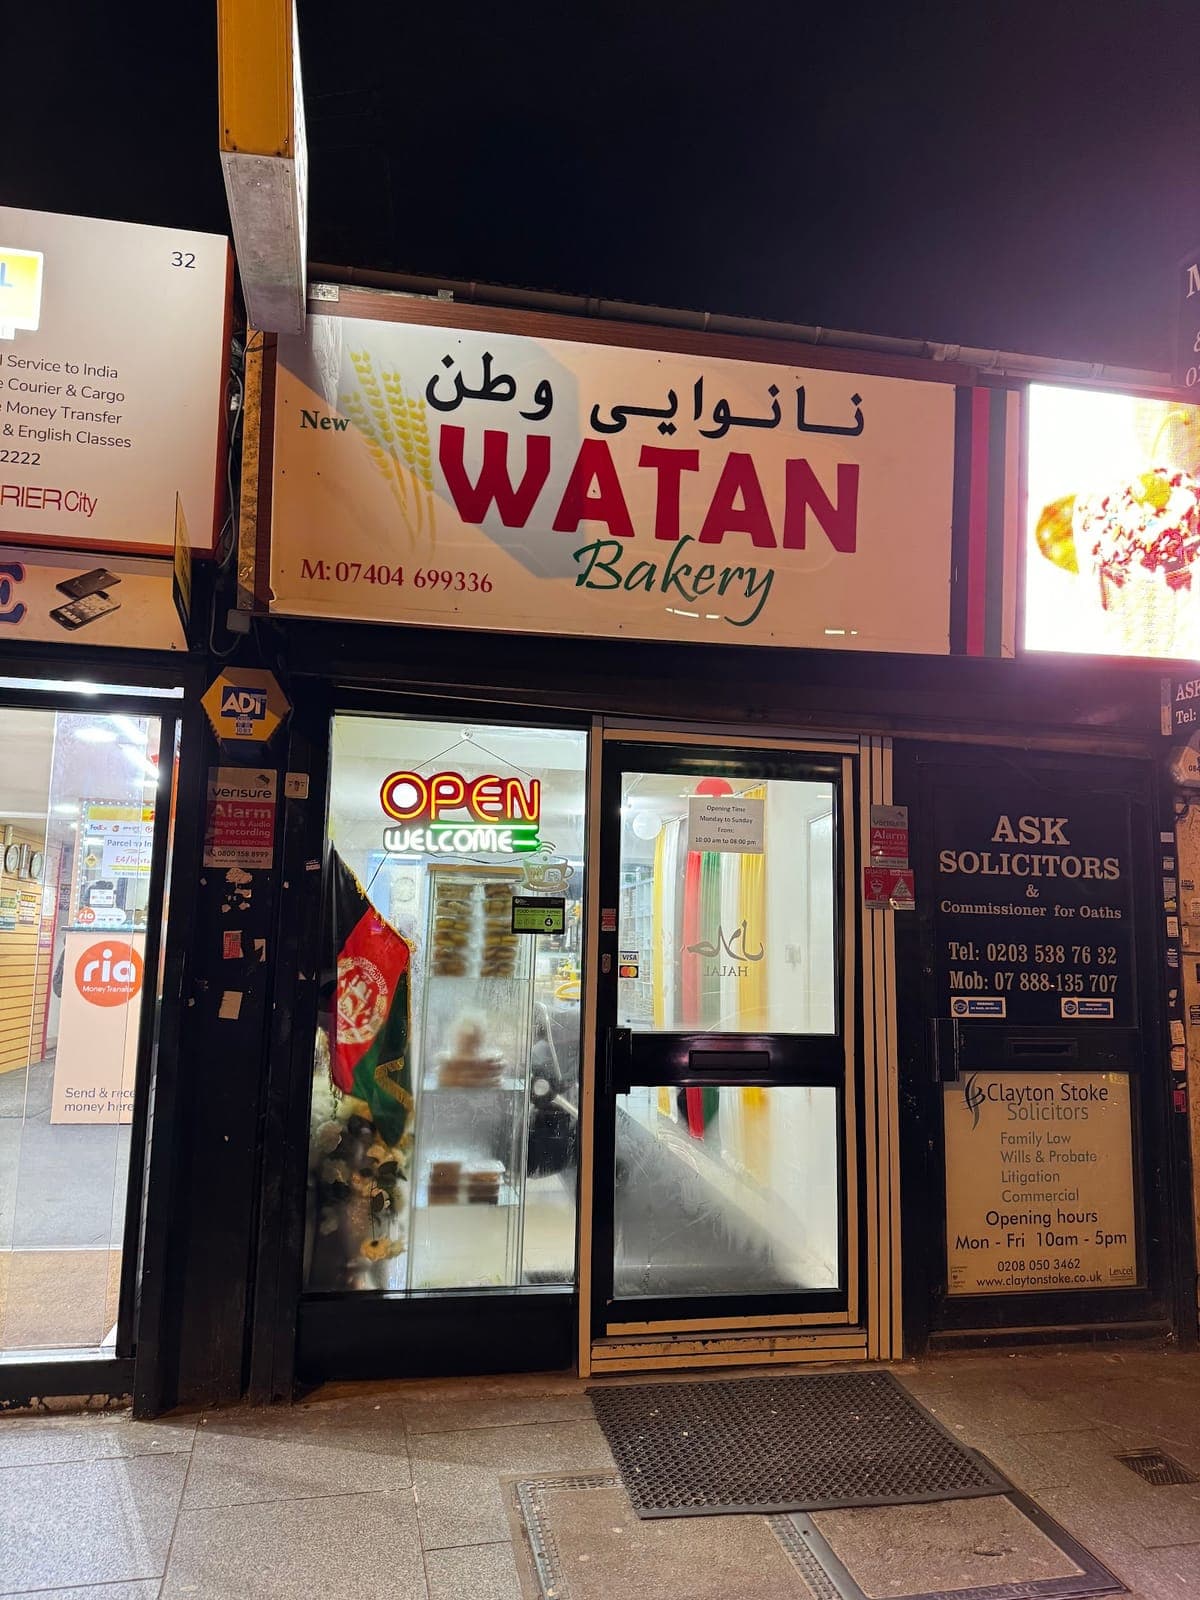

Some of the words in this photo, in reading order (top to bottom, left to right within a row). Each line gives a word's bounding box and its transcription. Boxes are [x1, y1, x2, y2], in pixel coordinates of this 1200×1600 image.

[172, 252, 196, 268] 32
[8, 355, 60, 372] Service
[66, 363, 79, 374] to
[84, 363, 118, 378] India
[8, 378, 62, 395] Courier
[66, 385, 77, 397] &
[82, 386, 124, 403] Cargo
[426, 352, 553, 420] وطن
[7, 401, 57, 420] Money
[61, 406, 122, 424] Transfer
[300, 410, 350, 432] New
[3, 424, 13, 436] &
[19, 425, 72, 442] English
[77, 431, 131, 448] Classes
[439, 424, 860, 554] WATAN
[414, 568, 493, 593] 699336
[573, 535, 774, 626] Bakery
[222, 692, 267, 714] ADT
[1176, 708, 1196, 724] Tel:
[382, 773, 539, 822] OPEN
[213, 804, 271, 818] Alarm
[384, 829, 513, 852] WELCOME
[991, 815, 1070, 845] ASK
[939, 850, 1120, 880] SOLICITORS
[1026, 884, 1040, 898] &
[940, 900, 1046, 916] Commissioner
[1054, 904, 1075, 918] for
[1080, 906, 1121, 919] Oaths
[949, 942, 980, 960] Tel:
[987, 943, 1028, 962] 0203
[1035, 945, 1065, 963] 538
[1072, 946, 1091, 965] 76
[1098, 946, 1117, 965] 32
[83, 948, 136, 982] ria
[950, 970, 988, 989] Mob:
[994, 972, 1014, 990] 07
[1020, 972, 1050, 991] 888
[1056, 973, 1083, 992] 135
[1089, 974, 1118, 992] 707
[65, 1087, 95, 1098] Send
[99, 1088, 108, 1098] &
[987, 1083, 1054, 1106] Clayton
[1060, 1083, 1108, 1101] Stoke
[64, 1103, 103, 1112] money
[1008, 1103, 1089, 1121] Solicitors
[1000, 1132, 1042, 1147] Family
[1047, 1132, 1071, 1144] Law
[1001, 1150, 1031, 1163] Wills
[1035, 1151, 1045, 1163] &
[1049, 1150, 1097, 1163] Probate
[1001, 1170, 1060, 1185] Litigation
[1002, 1188, 1080, 1203] Commercial
[986, 1210, 1051, 1229] Opening
[1057, 1208, 1098, 1224] hours
[955, 1235, 989, 1250] Mon
[1007, 1233, 1025, 1248] Fri
[1036, 1232, 1078, 1246] 10am
[1095, 1231, 1127, 1248] 5pm
[997, 1261, 1025, 1272] 0208
[1029, 1260, 1050, 1271] 050
[1054, 1259, 1080, 1270] 3462
[976, 1271, 1102, 1288] www.claytonstoke.co.uk
